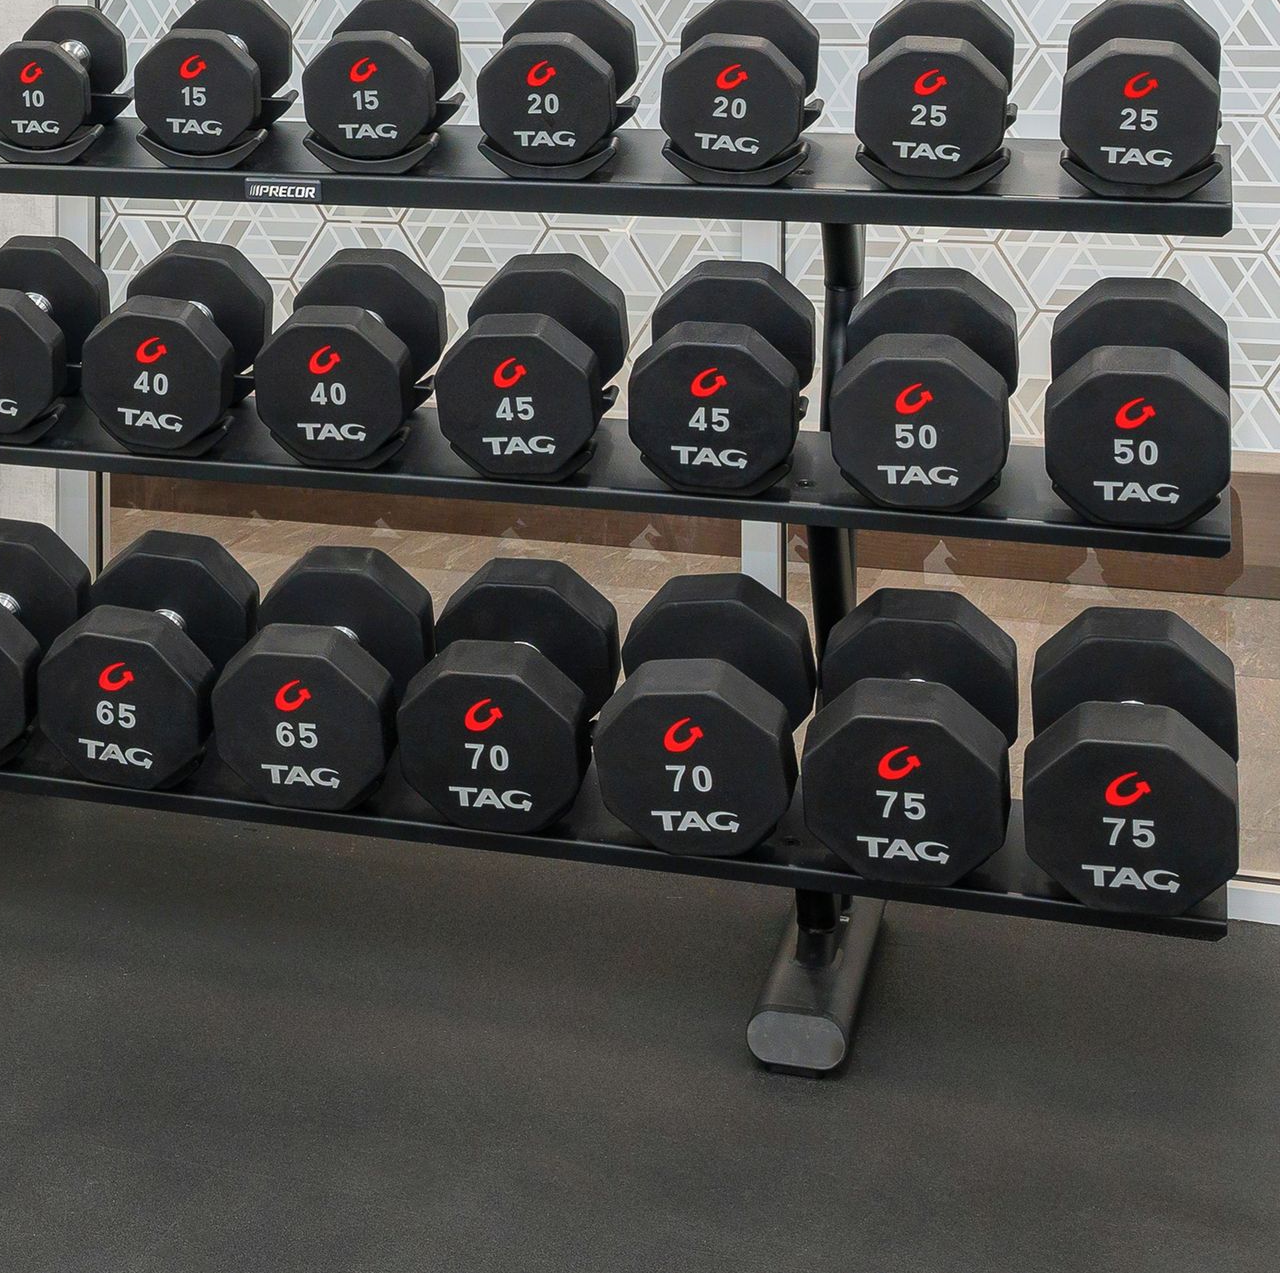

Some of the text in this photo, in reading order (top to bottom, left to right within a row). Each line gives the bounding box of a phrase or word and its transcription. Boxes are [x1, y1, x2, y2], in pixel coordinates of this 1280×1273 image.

[22, 89, 45, 108] 10
[181, 86, 207, 107] 15
[352, 90, 380, 111] 15
[527, 93, 560, 115] 20
[712, 95, 747, 119] 20
[9, 118, 62, 136] TAG
[164, 116, 224, 137] TAG
[910, 104, 947, 127] 25
[1119, 107, 1159, 132] 25
[337, 122, 399, 141] TAG
[512, 129, 578, 149] TAG
[691, 131, 762, 156] TAG
[890, 140, 962, 163] TAG
[1099, 145, 1175, 169] TAG
[259, 185, 316, 199] PRECOR
[133, 370, 169, 396] 40
[310, 382, 347, 406] 40
[116, 406, 184, 434] TAG
[495, 396, 535, 421] 45
[688, 406, 730, 433] 45
[295, 421, 368, 443] TAG
[895, 423, 938, 450] 50
[481, 434, 557, 457] TAG
[669, 444, 749, 470] TAG
[1113, 438, 1159, 466] 50
[876, 464, 960, 488] TAG
[1092, 479, 1181, 505] TAG
[96, 700, 136, 729] 65
[275, 721, 318, 749] 65
[77, 736, 154, 771] TAG
[464, 742, 509, 771] 70
[259, 762, 342, 790] TAG
[664, 764, 713, 793] 70
[447, 784, 534, 813] TAG
[875, 789, 926, 821] 75
[649, 809, 741, 834] TAG
[1102, 816, 1156, 848] 75
[855, 834, 951, 866] TAG
[1080, 863, 1181, 895] TAG
